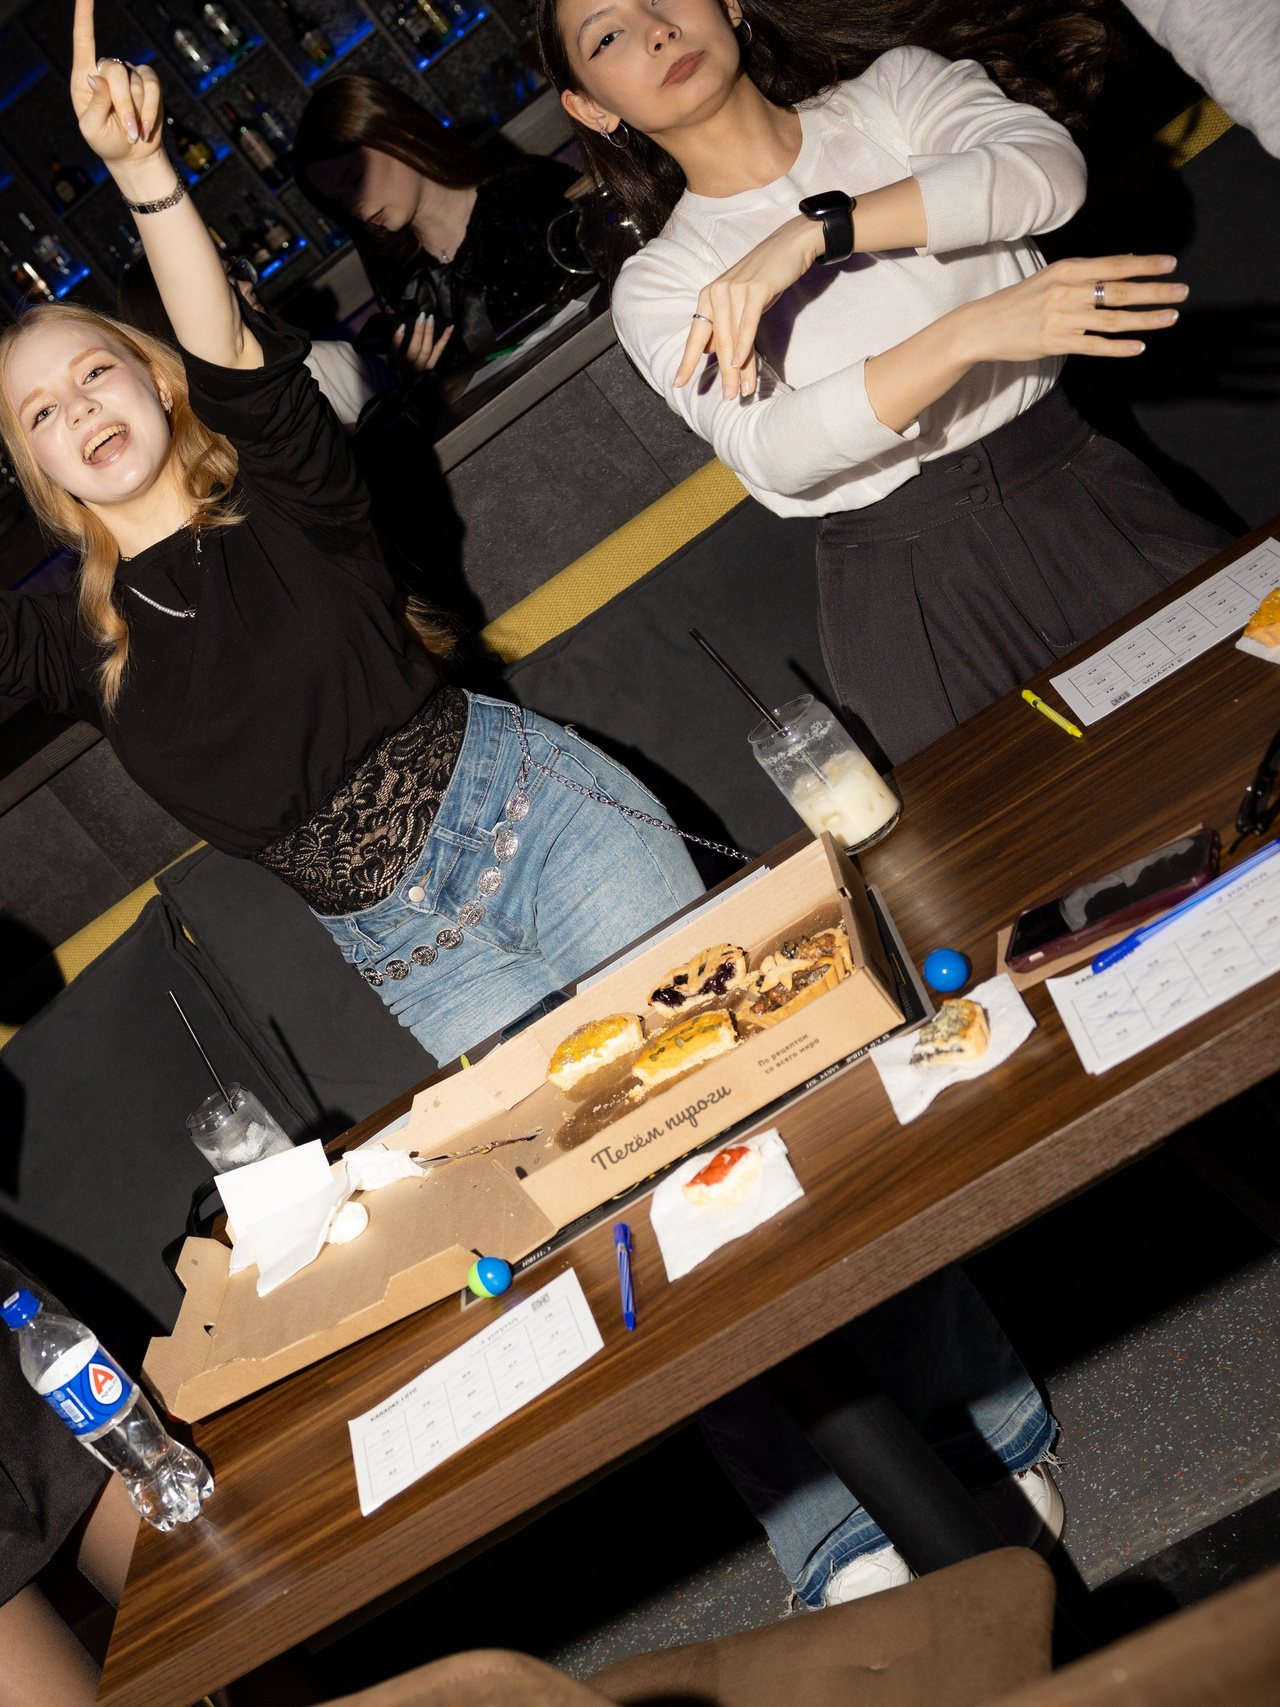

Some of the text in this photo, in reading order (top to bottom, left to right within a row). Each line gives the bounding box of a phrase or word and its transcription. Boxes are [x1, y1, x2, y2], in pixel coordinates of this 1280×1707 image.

[757, 1033, 809, 1068] По рецептам
[764, 1037, 820, 1075] со всего мира
[590, 1085, 732, 1171] Печём пироги
[92, 1367, 115, 1396] A
